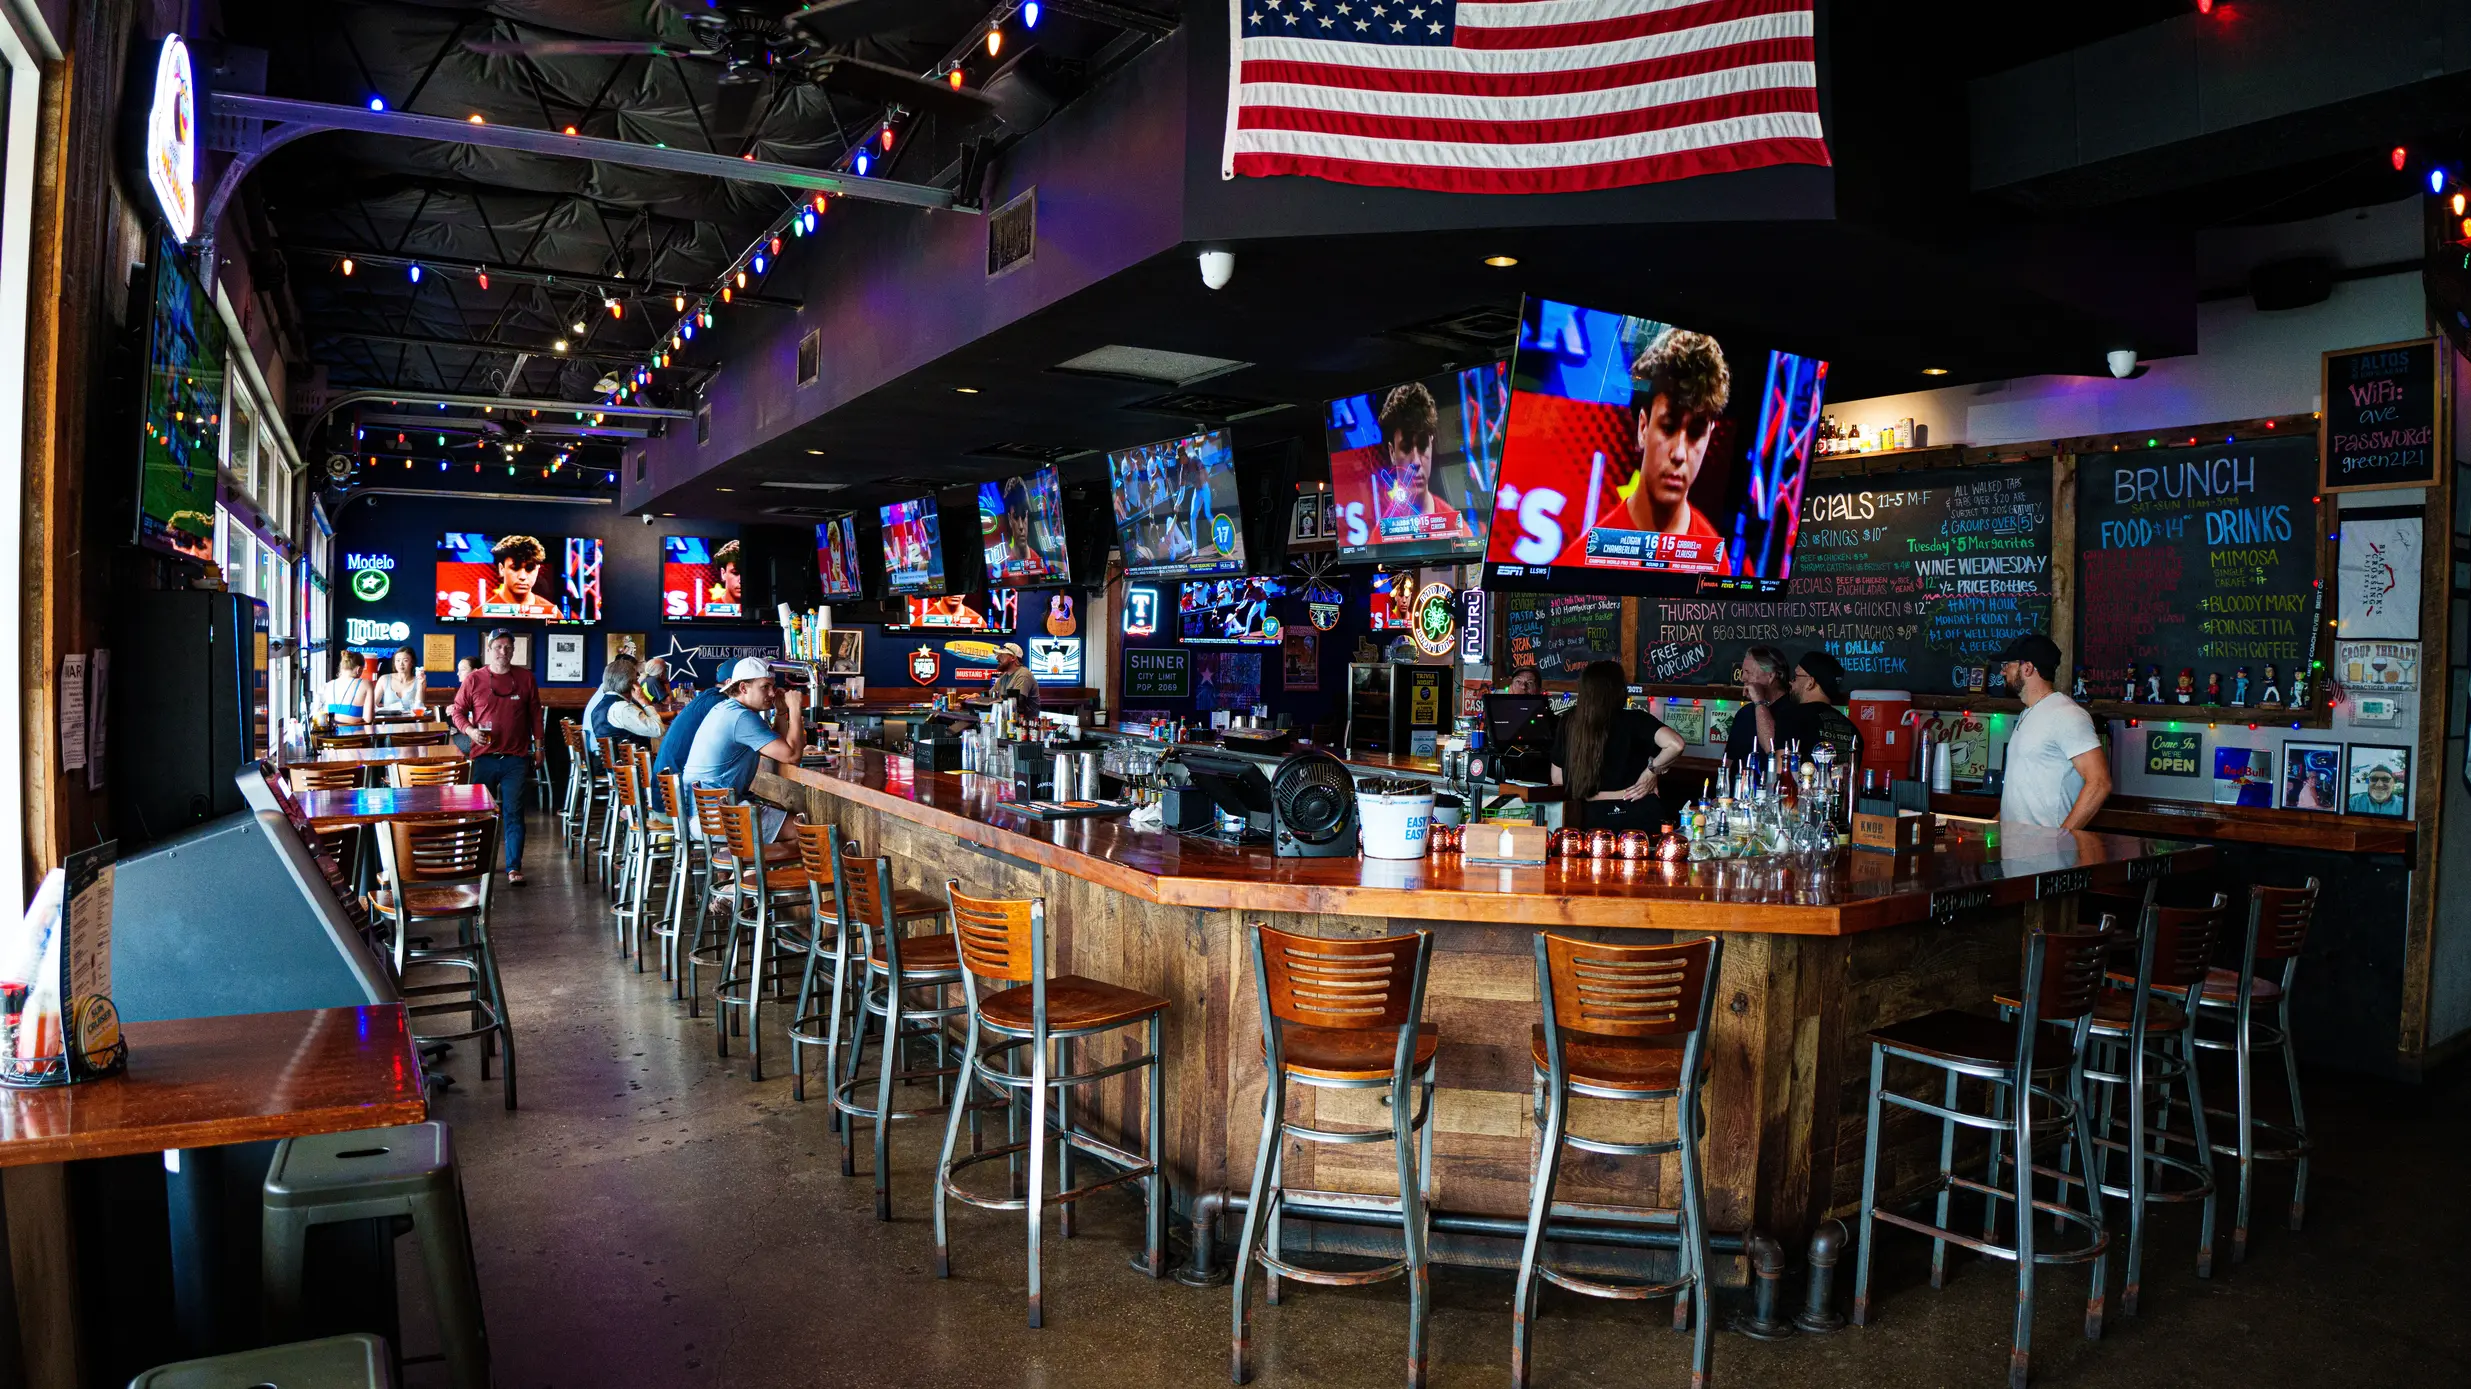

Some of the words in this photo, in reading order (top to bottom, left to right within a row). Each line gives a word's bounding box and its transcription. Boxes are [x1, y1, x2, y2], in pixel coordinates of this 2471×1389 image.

[2361, 352, 2410, 370] ALTOS
[2348, 379, 2403, 407] WiFi:
[2359, 406, 2399, 424] ave
[2342, 450, 2423, 473] green2121
[1955, 484, 1968, 497] ALL
[1971, 481, 2002, 495] WALKED
[2006, 477, 2022, 491] TABS
[2115, 457, 2254, 504] BRUNCH
[1954, 495, 1970, 507] TABS
[1972, 494, 1990, 506] OVER
[2013, 491, 2026, 503] ARE
[1981, 506, 1988, 515] TO
[1992, 504, 2007, 515] 20%
[1951, 518, 1990, 534] GROUPS
[1992, 516, 2016, 530] OVER
[2205, 505, 2292, 545] DRINKS
[1217, 526, 1229, 543] 17
[1645, 534, 1658, 550] 16
[1662, 536, 1676, 550] 15
[1821, 529, 1859, 547] RINGS
[2101, 518, 2152, 550] FOOD
[1603, 544, 1639, 554] CHAMBERLAIN
[1907, 538, 1950, 556] Tuesday
[1951, 536, 1967, 552] $5
[1968, 535, 2035, 552] Margaritas
[348, 553, 395, 570] Modelo
[1915, 558, 1955, 577] WINE
[1957, 555, 2047, 576] WEDNESDAY
[2210, 549, 2279, 568] MIMOSA
[2378, 544, 2386, 575] BLACK
[1497, 565, 1524, 576] ESPN
[2213, 567, 2245, 577] SINGLE
[2369, 553, 2378, 605] CROSSING
[1788, 577, 1833, 595] SPECIALS
[1836, 576, 1854, 584] BEEF
[1862, 576, 1888, 584] CHICKEN
[1837, 585, 1888, 596] ENCHILADAS
[1957, 578, 1988, 593] PRICE
[1990, 578, 2037, 593] Bottles
[2215, 576, 2247, 588] CARAFE
[1550, 606, 1561, 616] $10
[1564, 603, 1597, 615] Hamburger
[1598, 600, 1621, 610] Sliders
[1658, 602, 1726, 621] THURSDAY
[1731, 602, 1775, 618] CHICKEN
[1777, 602, 1807, 618] FRIED
[1809, 601, 1842, 618] STEAK
[1854, 601, 1900, 618] CHICKEN
[1948, 598, 1986, 611] HAPPY
[1989, 598, 2018, 611] HOUR
[2209, 594, 2263, 612] BLOODY
[2265, 594, 2306, 613] MARY
[1510, 611, 1534, 625] PASTA
[1935, 612, 2008, 626] MONDAY-FRIDAY
[2015, 612, 2039, 627] 4-7
[346, 618, 390, 645] Lite
[1511, 623, 1539, 636] SPECIAL
[1587, 627, 1608, 640] FRITO
[1660, 624, 1705, 641] FRIDAY
[1713, 624, 1734, 640] BBQ
[1736, 623, 1779, 640] SLIDERS
[1782, 625, 1793, 638] (3)
[1827, 624, 1853, 640] FLAT
[1855, 624, 1895, 641] NACHOS
[1945, 629, 1961, 639] OFF
[1964, 628, 1989, 638] WELL
[2210, 618, 2294, 636] POINSETTIA
[702, 647, 730, 658] DALLAS
[733, 647, 767, 658] COWBOYS
[1511, 637, 1532, 653] STEAK
[1591, 640, 1602, 652] PIE
[1650, 642, 1679, 665] FREE
[1845, 640, 1885, 655] DALLAS
[1969, 640, 2001, 651] BEERS
[2210, 641, 2247, 659] IRISH
[2249, 640, 2299, 659] COFFEE
[2309, 632, 2318, 659] COACH
[1131, 655, 1184, 669] SHINER
[1512, 654, 1537, 668] SPECIAL
[1539, 653, 1562, 670] CHILI
[1656, 644, 1705, 679] POPCORN
[2341, 645, 2371, 663] GROUP
[2376, 645, 2416, 661] THERAPY
[914, 662, 935, 673] 140
[1836, 656, 1908, 673] HEESESTEAK
[1138, 673, 1154, 681] CITY
[1158, 673, 1176, 681] LIMIT
[1136, 684, 1154, 692] POP.
[1920, 717, 1984, 744] Coffee
[2152, 735, 2181, 750] Come
[2183, 737, 2196, 750] In
[2150, 757, 2195, 772] OPEN
[1407, 816, 1427, 828] EASY
[1860, 820, 1884, 833] KNOB
[1405, 829, 1424, 840] EASY
[2044, 870, 2092, 897] SHELBY
